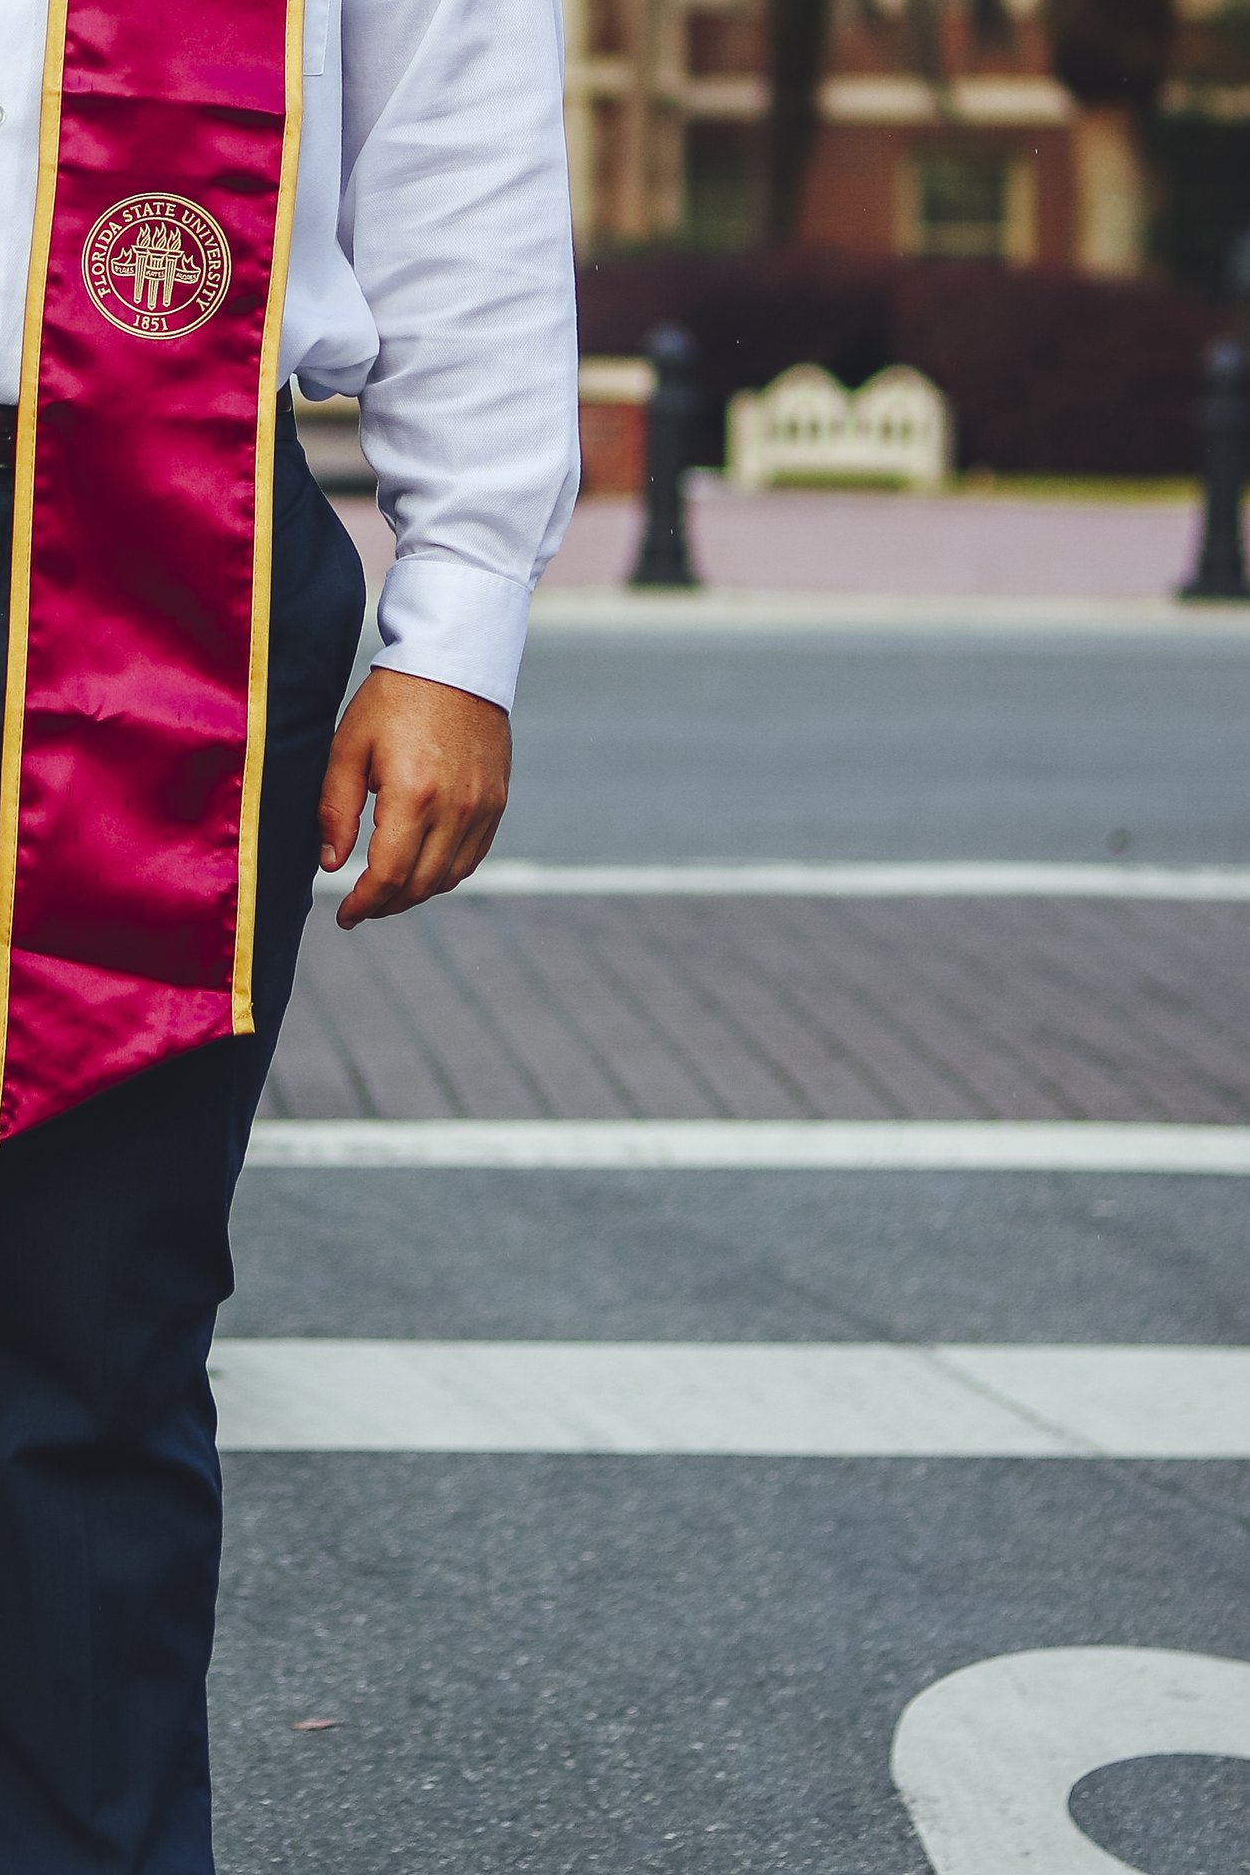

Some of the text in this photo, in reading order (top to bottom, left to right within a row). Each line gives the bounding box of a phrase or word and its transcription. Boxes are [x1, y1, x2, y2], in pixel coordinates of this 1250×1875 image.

[91, 202, 222, 312] FLORIDA STATE UNIVERSITY
[133, 314, 169, 332] 1851
